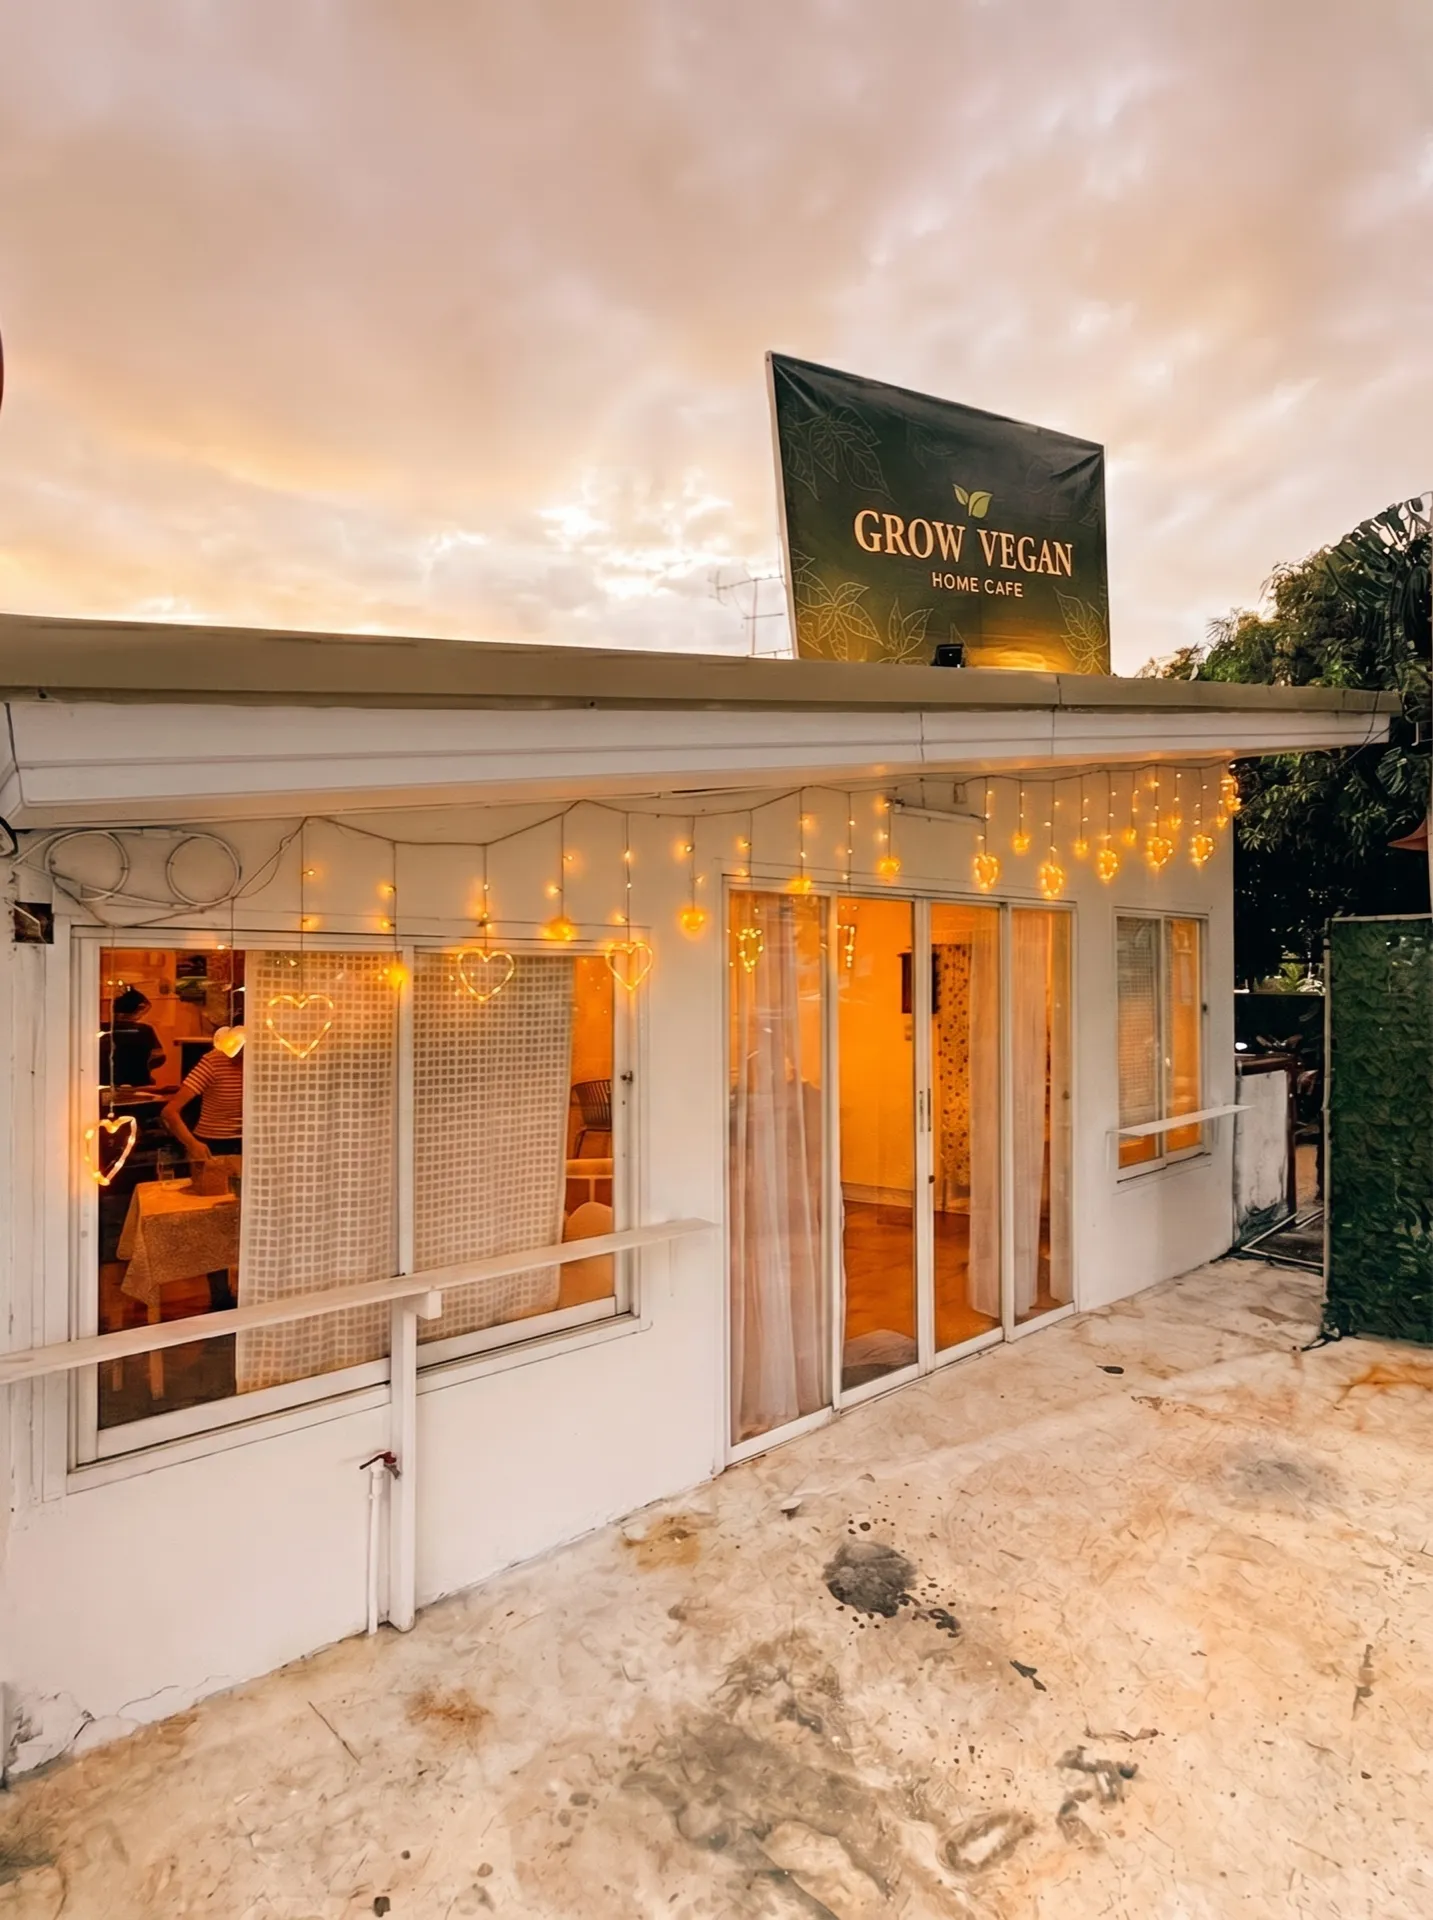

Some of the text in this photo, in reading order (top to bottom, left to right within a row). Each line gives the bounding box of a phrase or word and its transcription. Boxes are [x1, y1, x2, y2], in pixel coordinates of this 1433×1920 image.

[854, 510, 1073, 576] GROW VEGAN
[932, 572, 1023, 597] HOME CAFE
